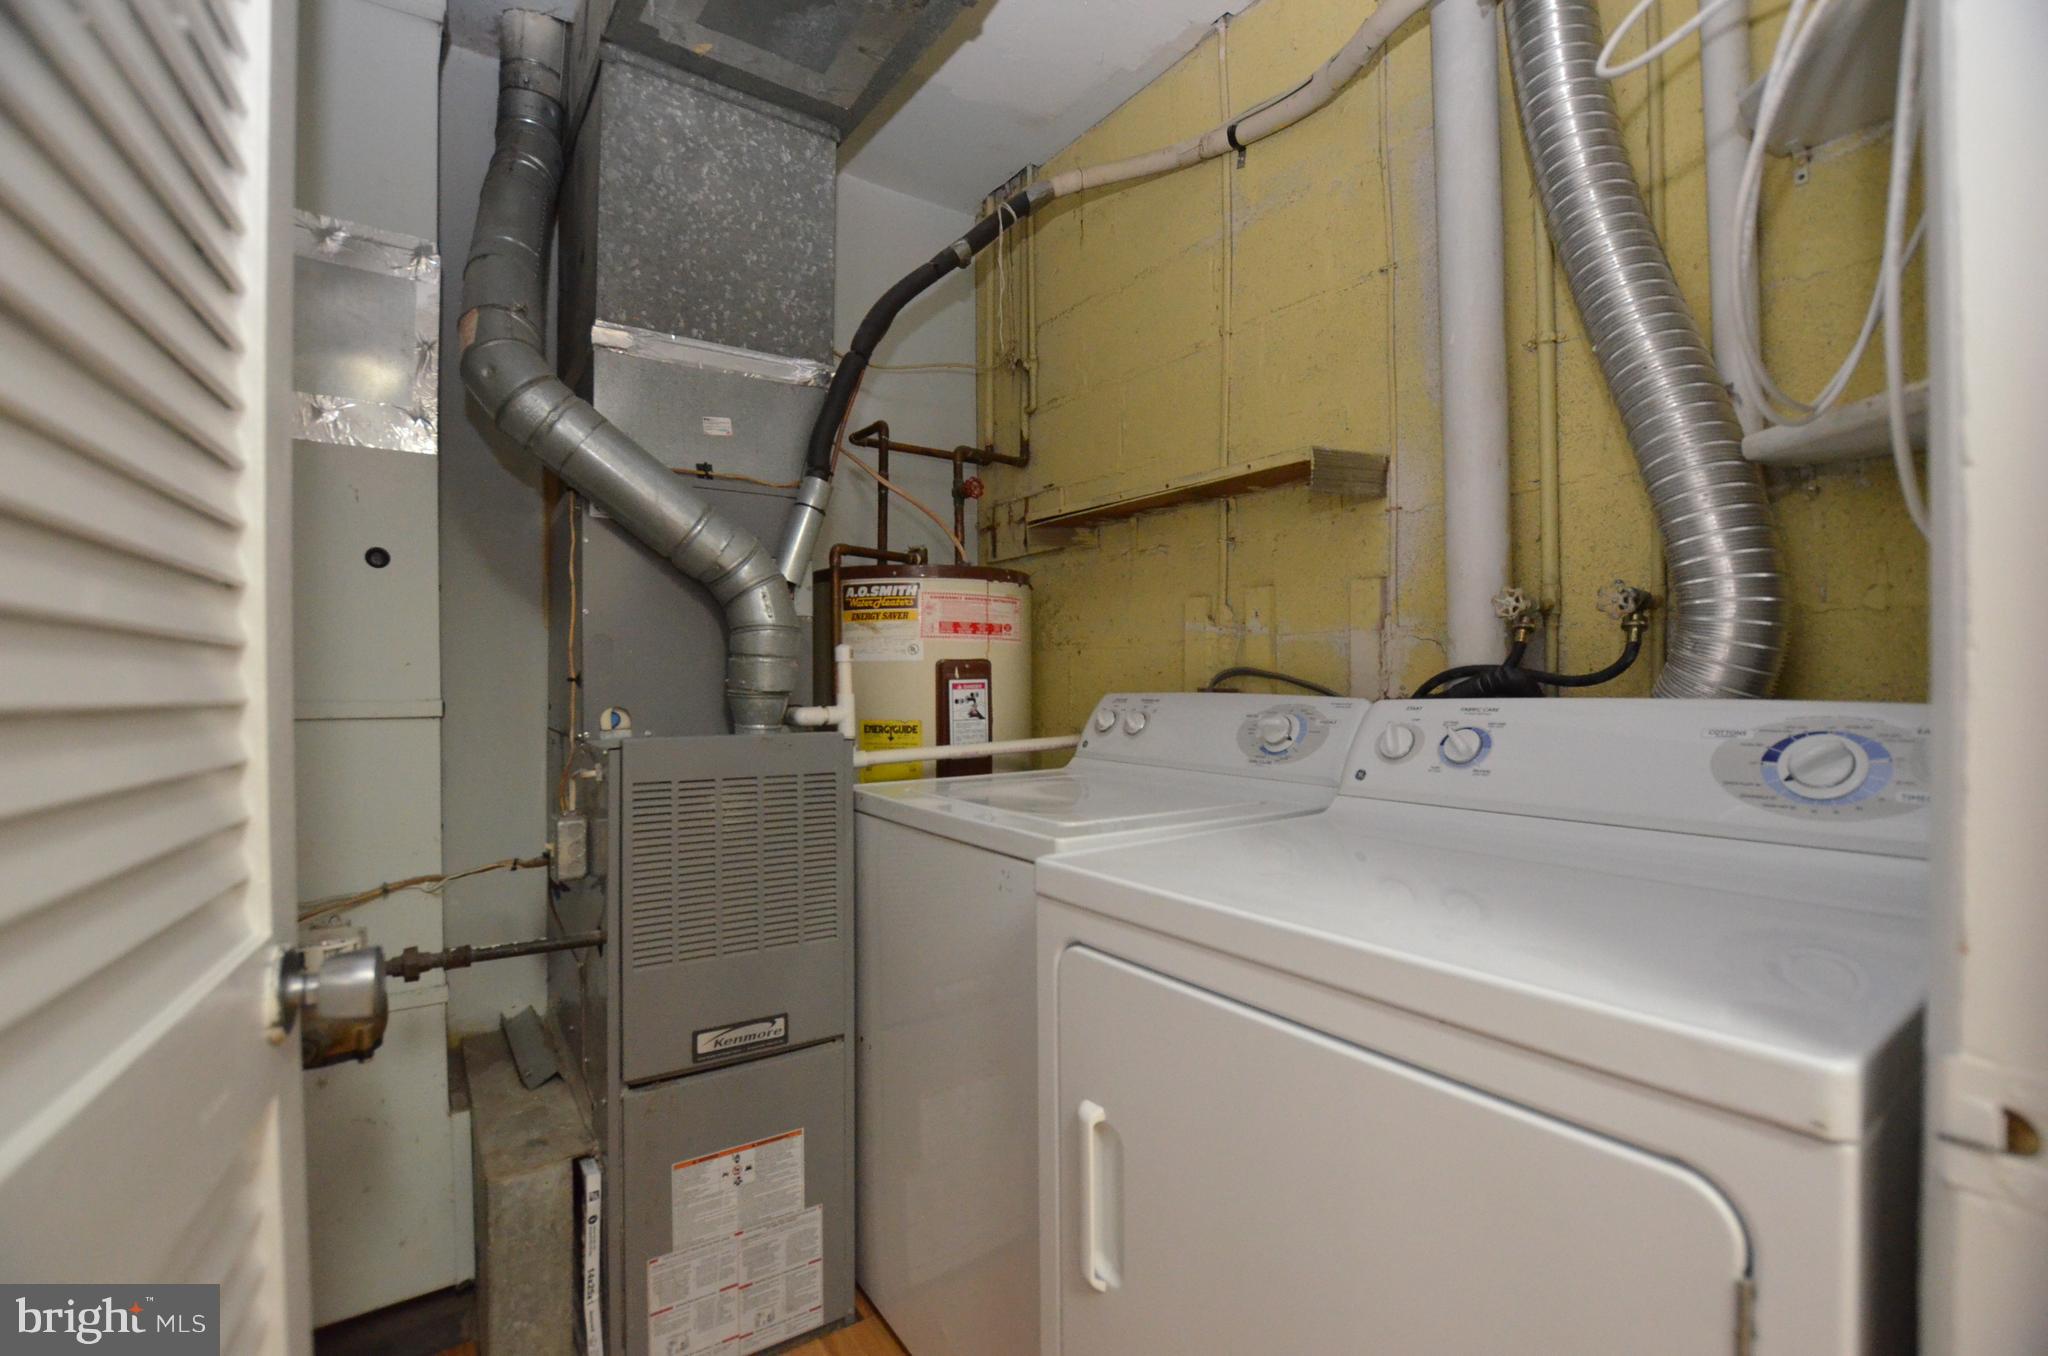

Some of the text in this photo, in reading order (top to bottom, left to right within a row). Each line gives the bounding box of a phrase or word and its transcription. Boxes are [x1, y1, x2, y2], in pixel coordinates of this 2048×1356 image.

[851, 611, 909, 621] ENERGY SAVER
[713, 1027, 783, 1049] Kenmore
